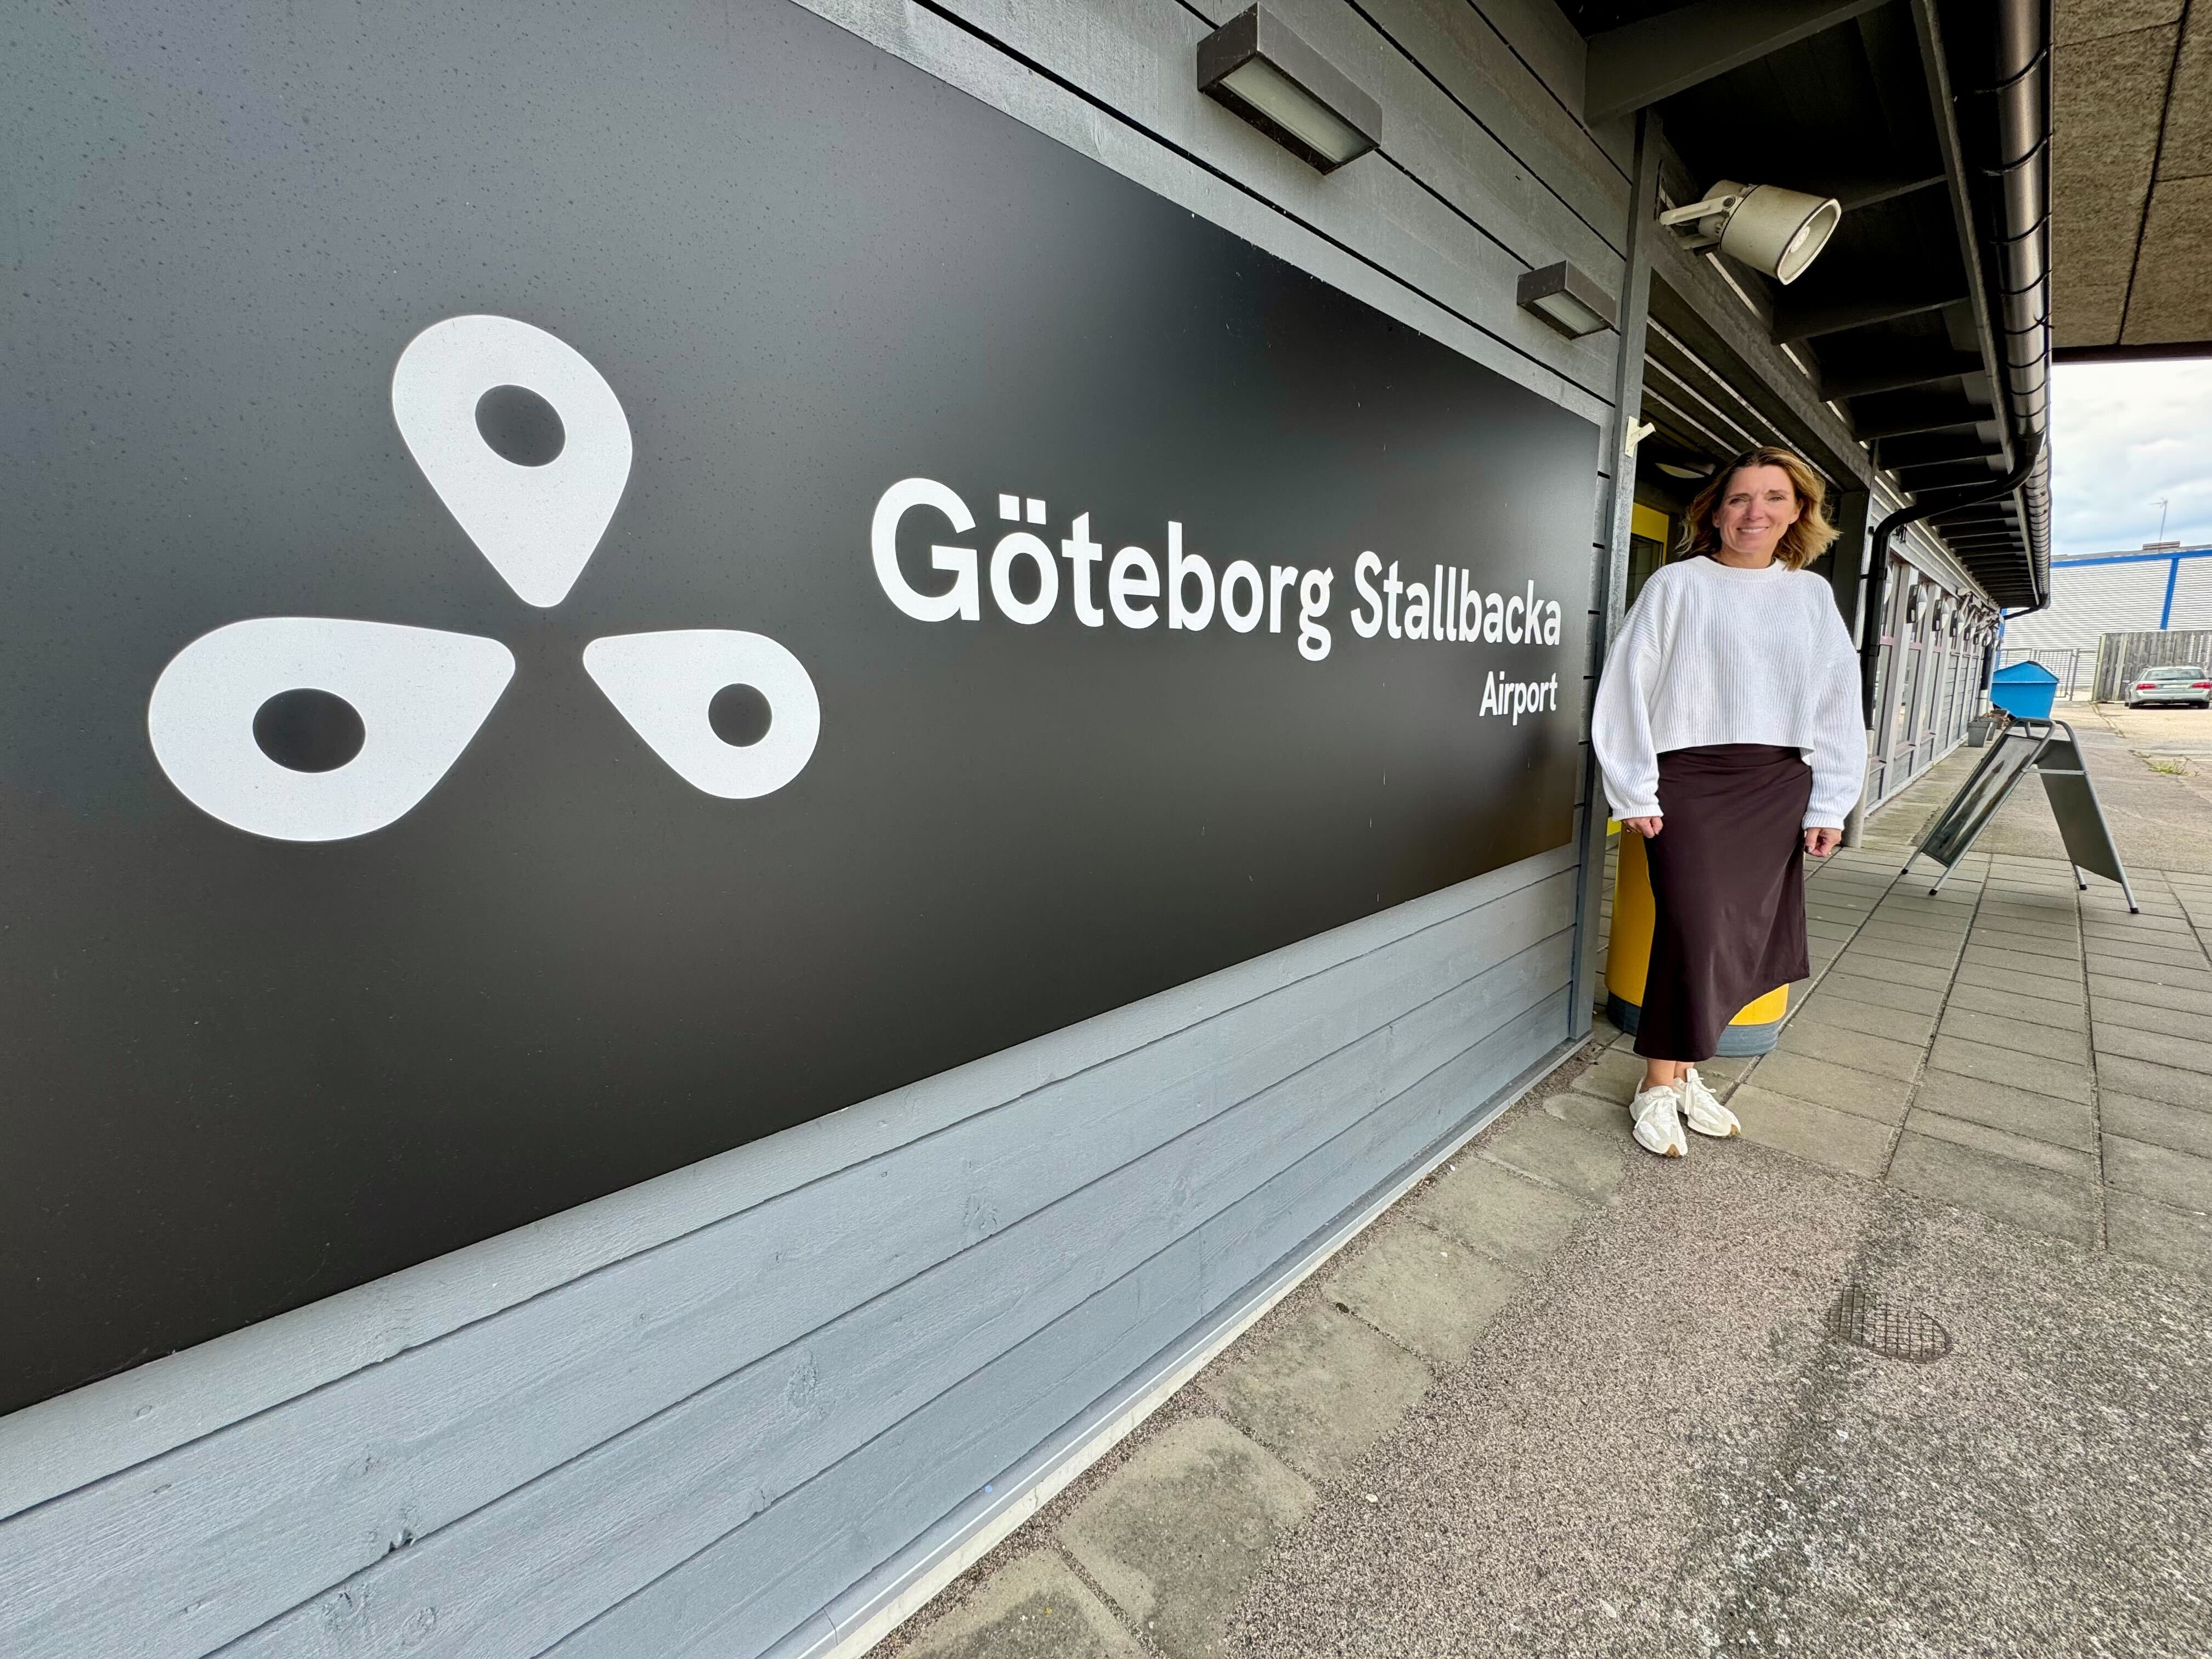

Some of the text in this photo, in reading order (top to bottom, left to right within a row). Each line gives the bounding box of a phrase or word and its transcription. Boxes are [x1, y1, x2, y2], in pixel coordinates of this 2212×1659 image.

[870, 476, 1562, 662] Göteborg Stallbacka
[1479, 670, 1559, 726] Airport
